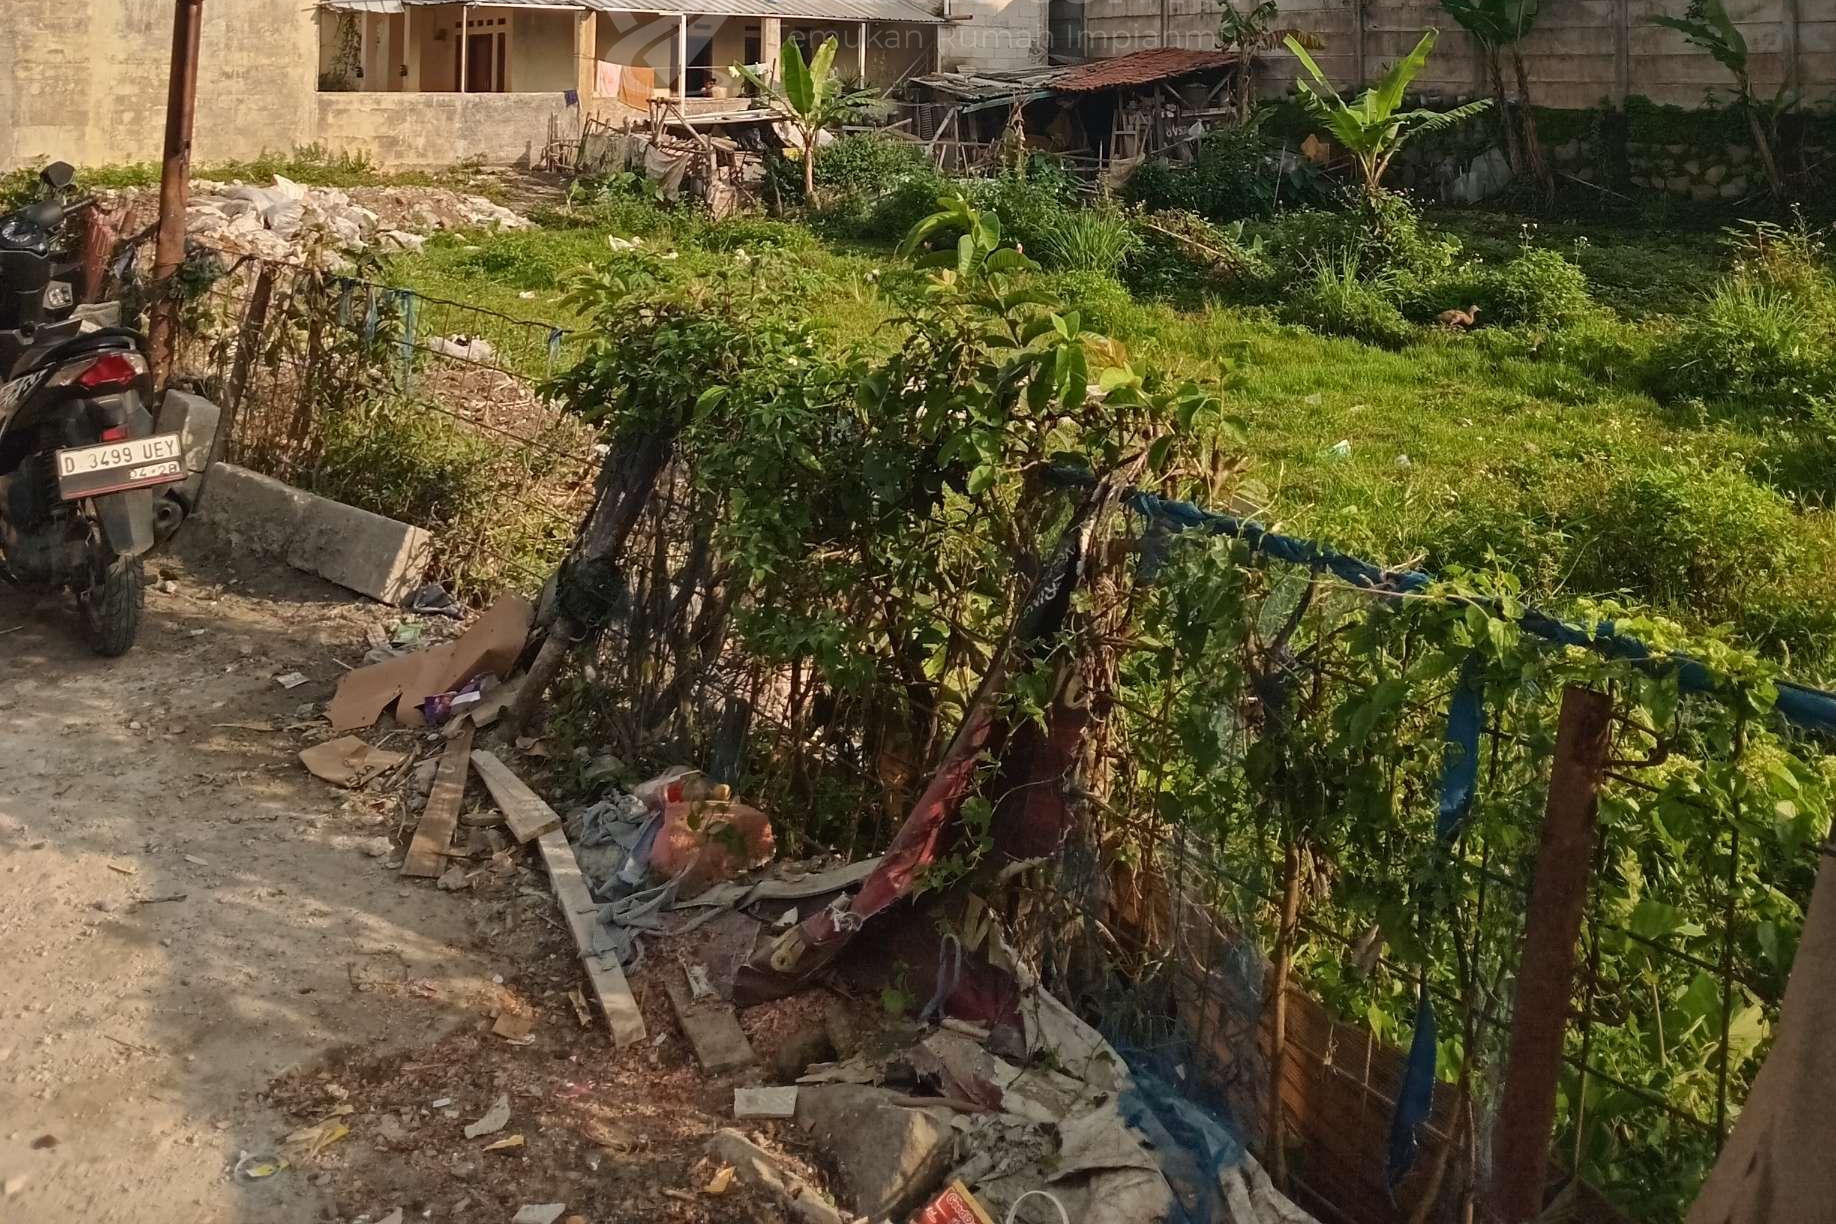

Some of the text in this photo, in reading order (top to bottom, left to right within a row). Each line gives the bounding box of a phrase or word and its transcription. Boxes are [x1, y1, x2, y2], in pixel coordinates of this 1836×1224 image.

[64, 438, 175, 474] D 3499 UEY
